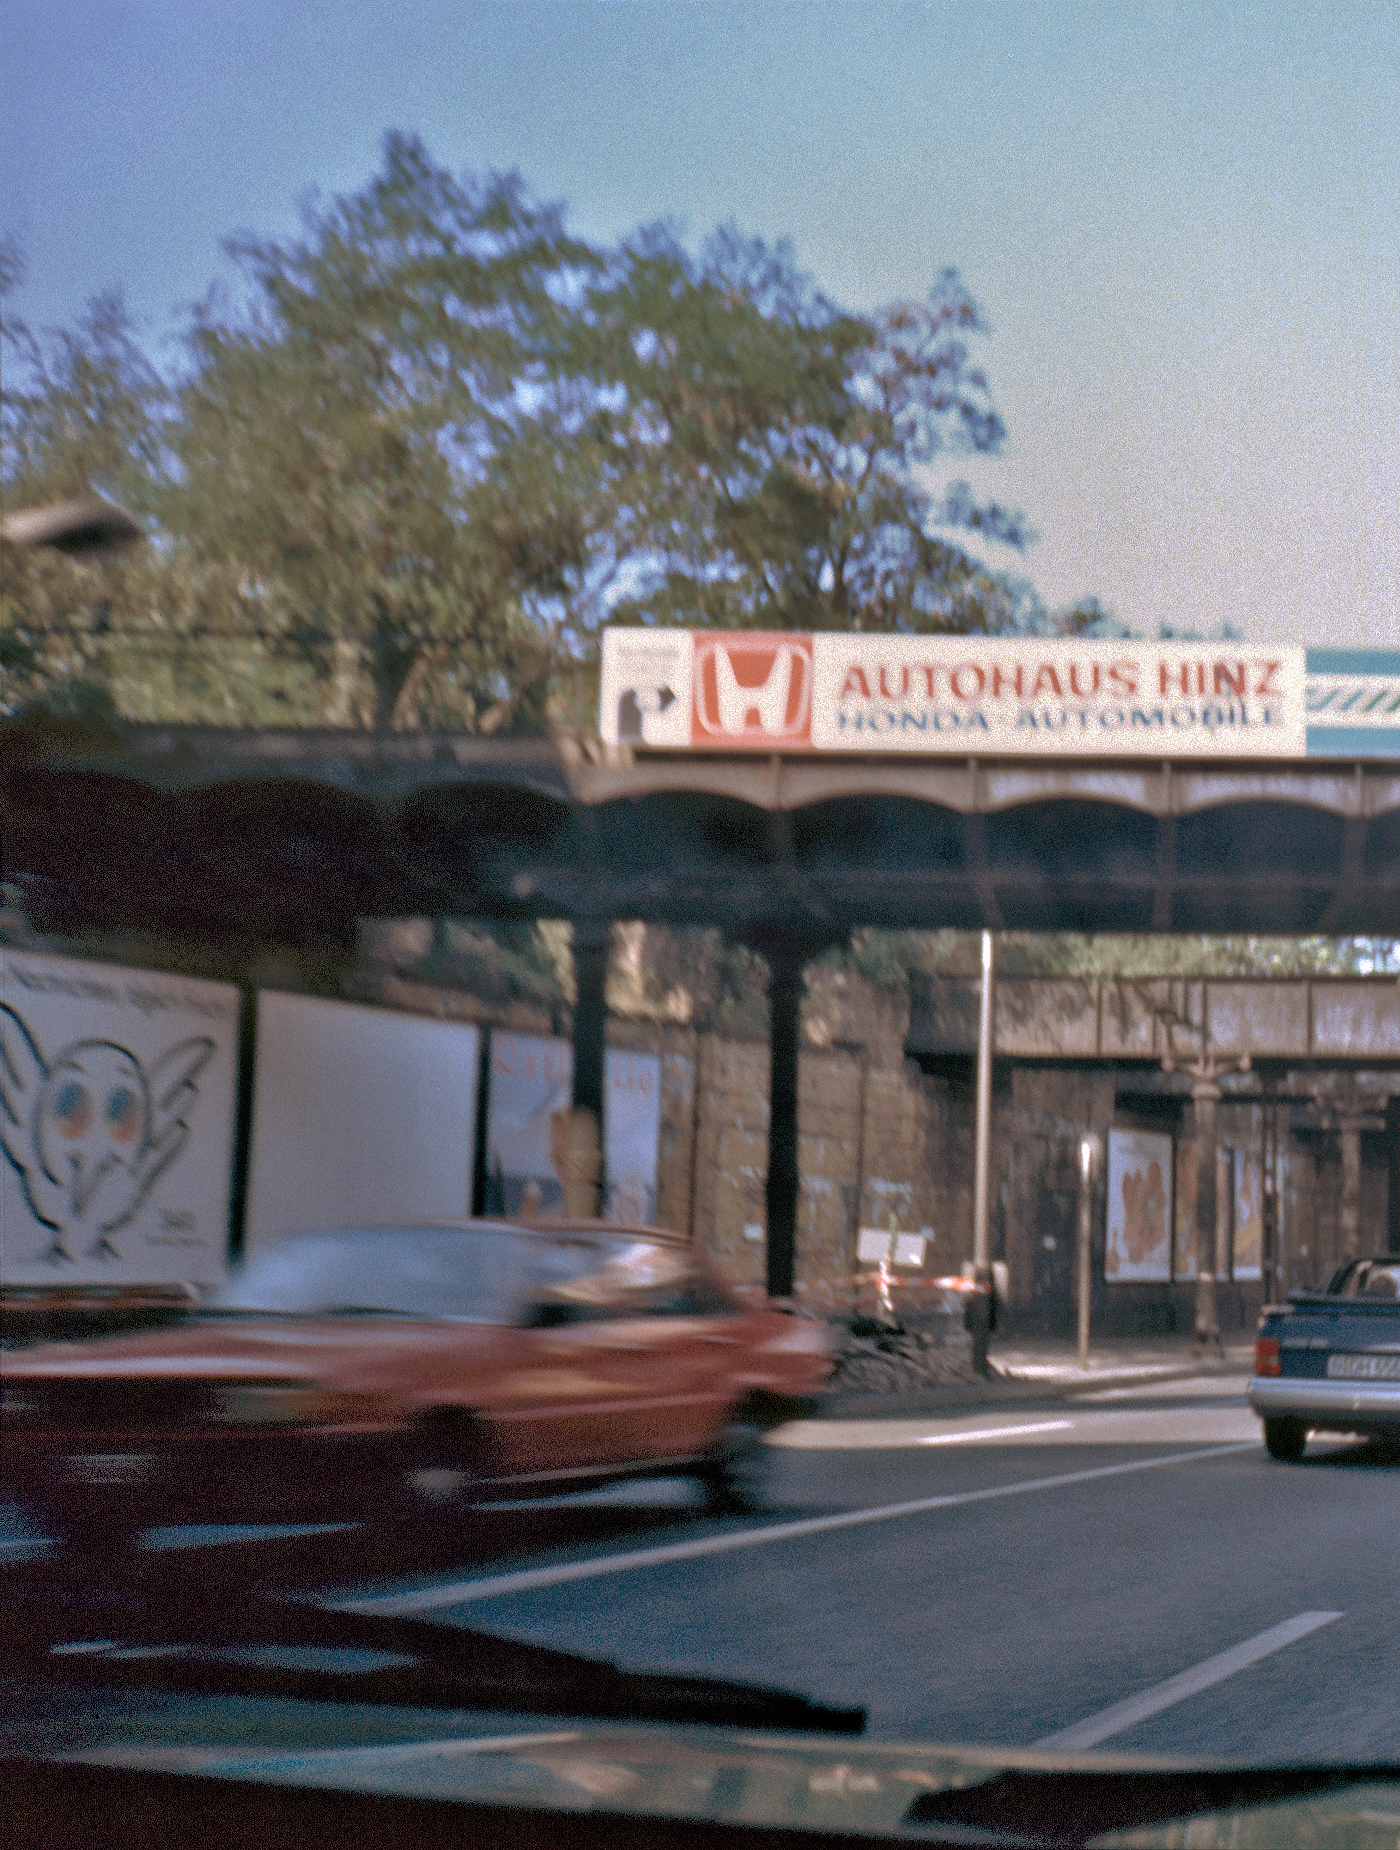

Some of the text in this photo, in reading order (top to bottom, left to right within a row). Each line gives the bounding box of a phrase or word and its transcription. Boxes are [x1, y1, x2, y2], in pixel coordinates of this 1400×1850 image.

[841, 662, 1283, 699] AUTOHAUS HINZ
[839, 710, 989, 733] HONDA
